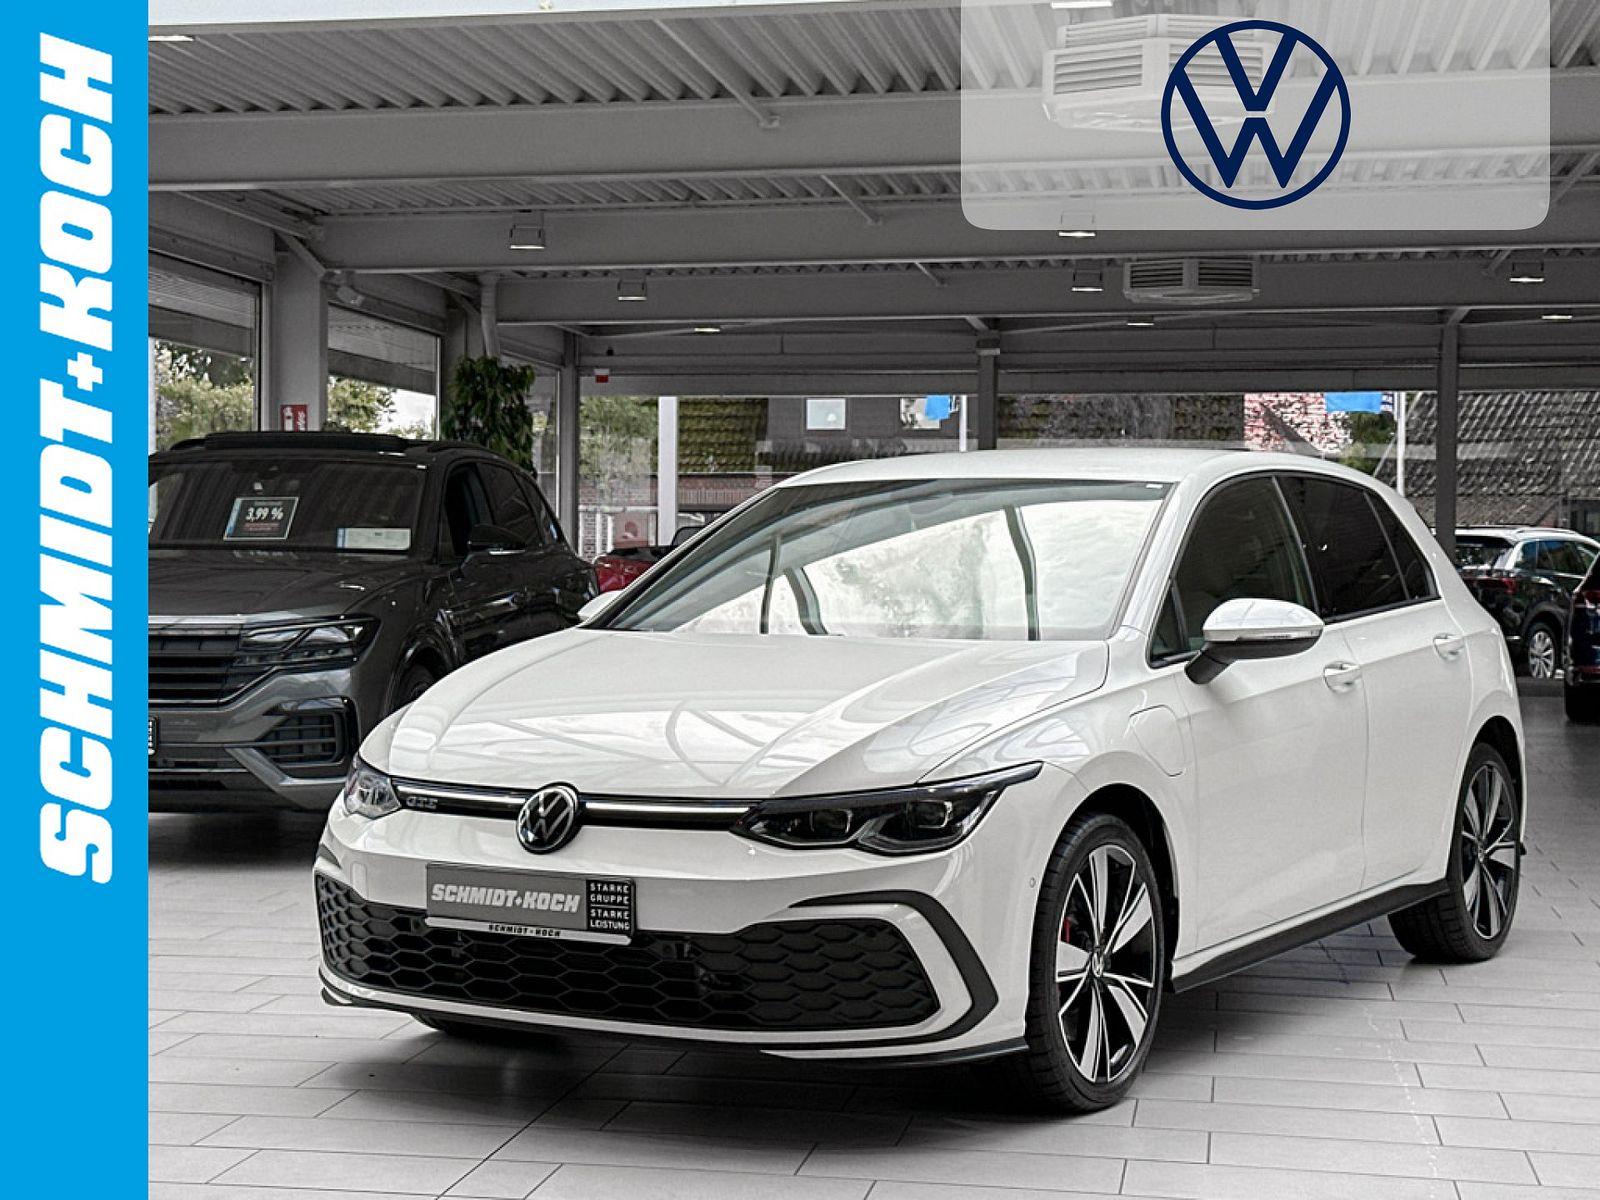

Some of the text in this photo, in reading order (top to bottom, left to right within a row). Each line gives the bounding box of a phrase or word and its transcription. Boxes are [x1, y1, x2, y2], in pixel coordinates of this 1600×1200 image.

[245, 507, 284, 522] 3,99 %
[590, 882, 629, 893] STARKE
[590, 893, 629, 904] GRUPPE
[590, 908, 629, 919] STARKE
[590, 919, 630, 930] LEISTUNG
